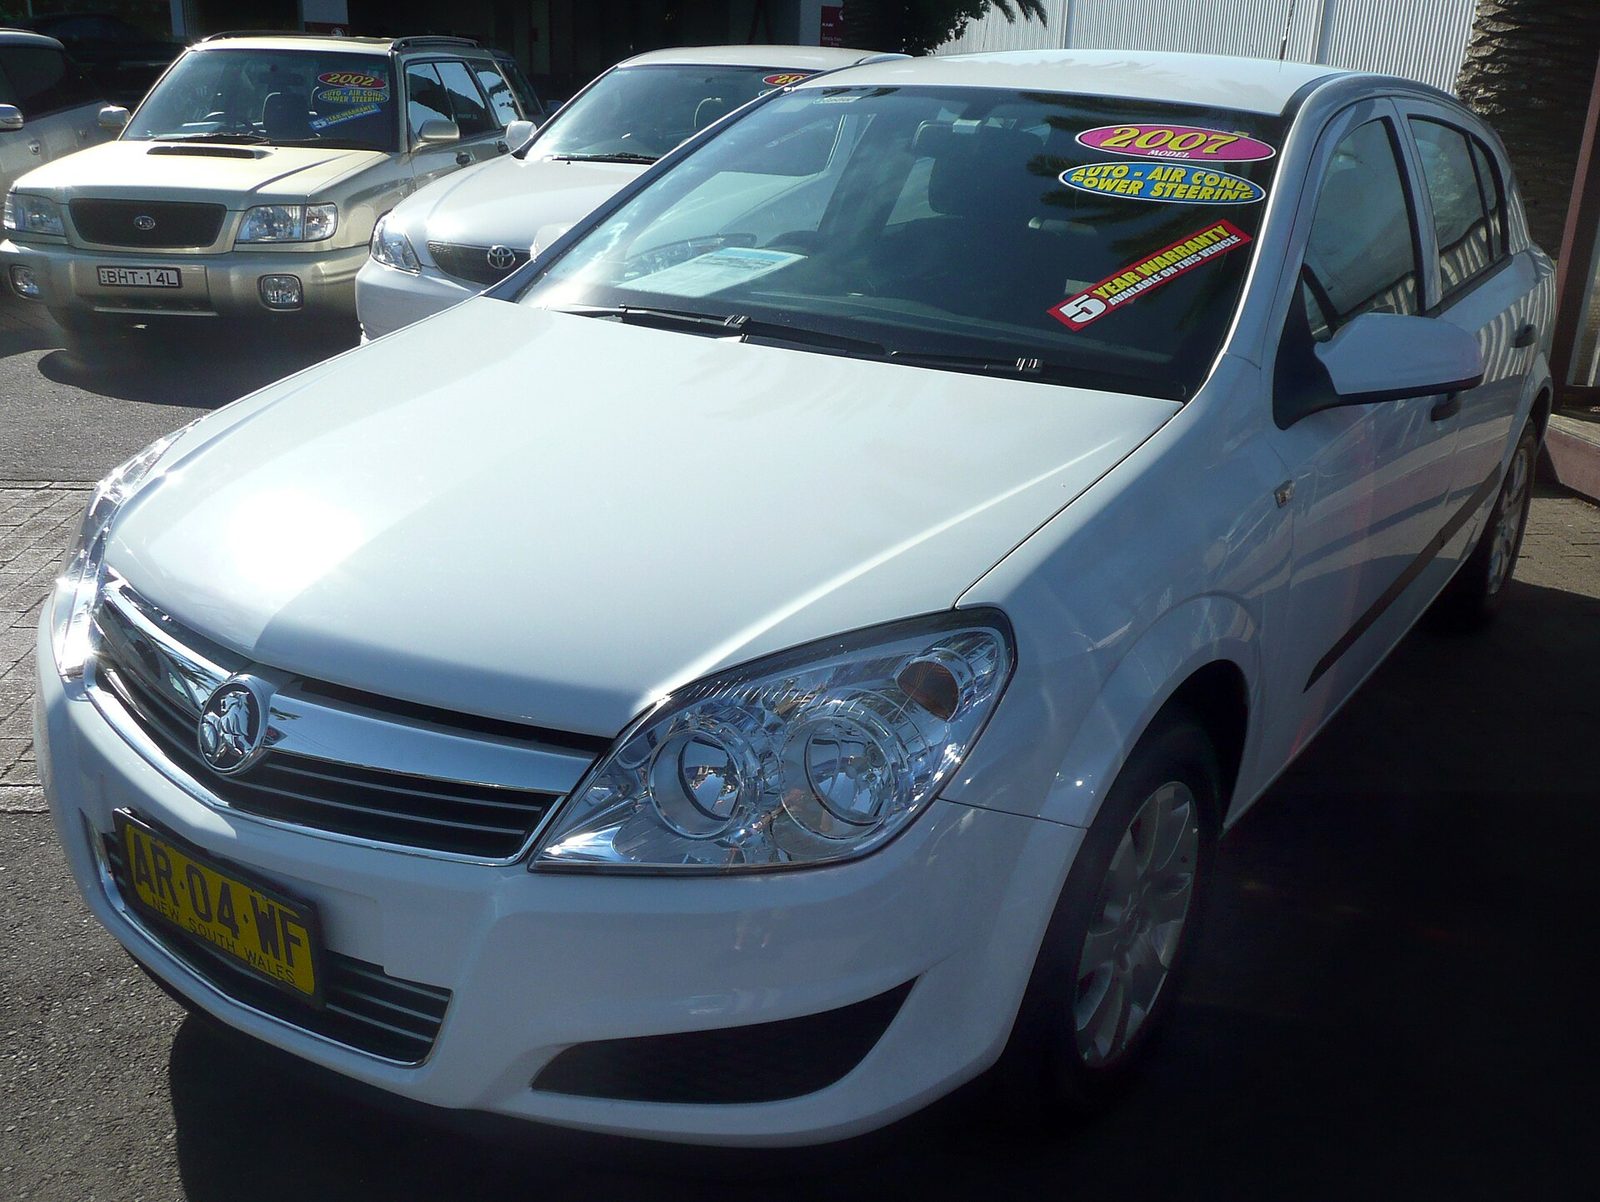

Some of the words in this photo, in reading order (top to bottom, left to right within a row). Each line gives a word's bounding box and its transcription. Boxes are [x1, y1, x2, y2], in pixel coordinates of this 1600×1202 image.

[327, 73, 375, 86] 2002
[1100, 127, 1239, 154] 2007
[1147, 149, 1190, 159] MODEL
[1072, 165, 1130, 178] AUTO
[1146, 166, 1187, 183] AIR
[1071, 175, 1144, 195] POWER
[1150, 182, 1254, 200] STEERING
[1058, 294, 1108, 324] 5
[1092, 271, 1142, 300] YEAR
[1135, 225, 1232, 277] WARRANTY
[1108, 274, 1164, 306] AVAILABLE
[1161, 266, 1179, 278] ON
[1175, 253, 1201, 270] THIS
[1199, 234, 1242, 259] VEHICLE
[151, 895, 181, 922] NEW
[187, 917, 236, 951] SOUTH
[244, 946, 296, 984] WALES
